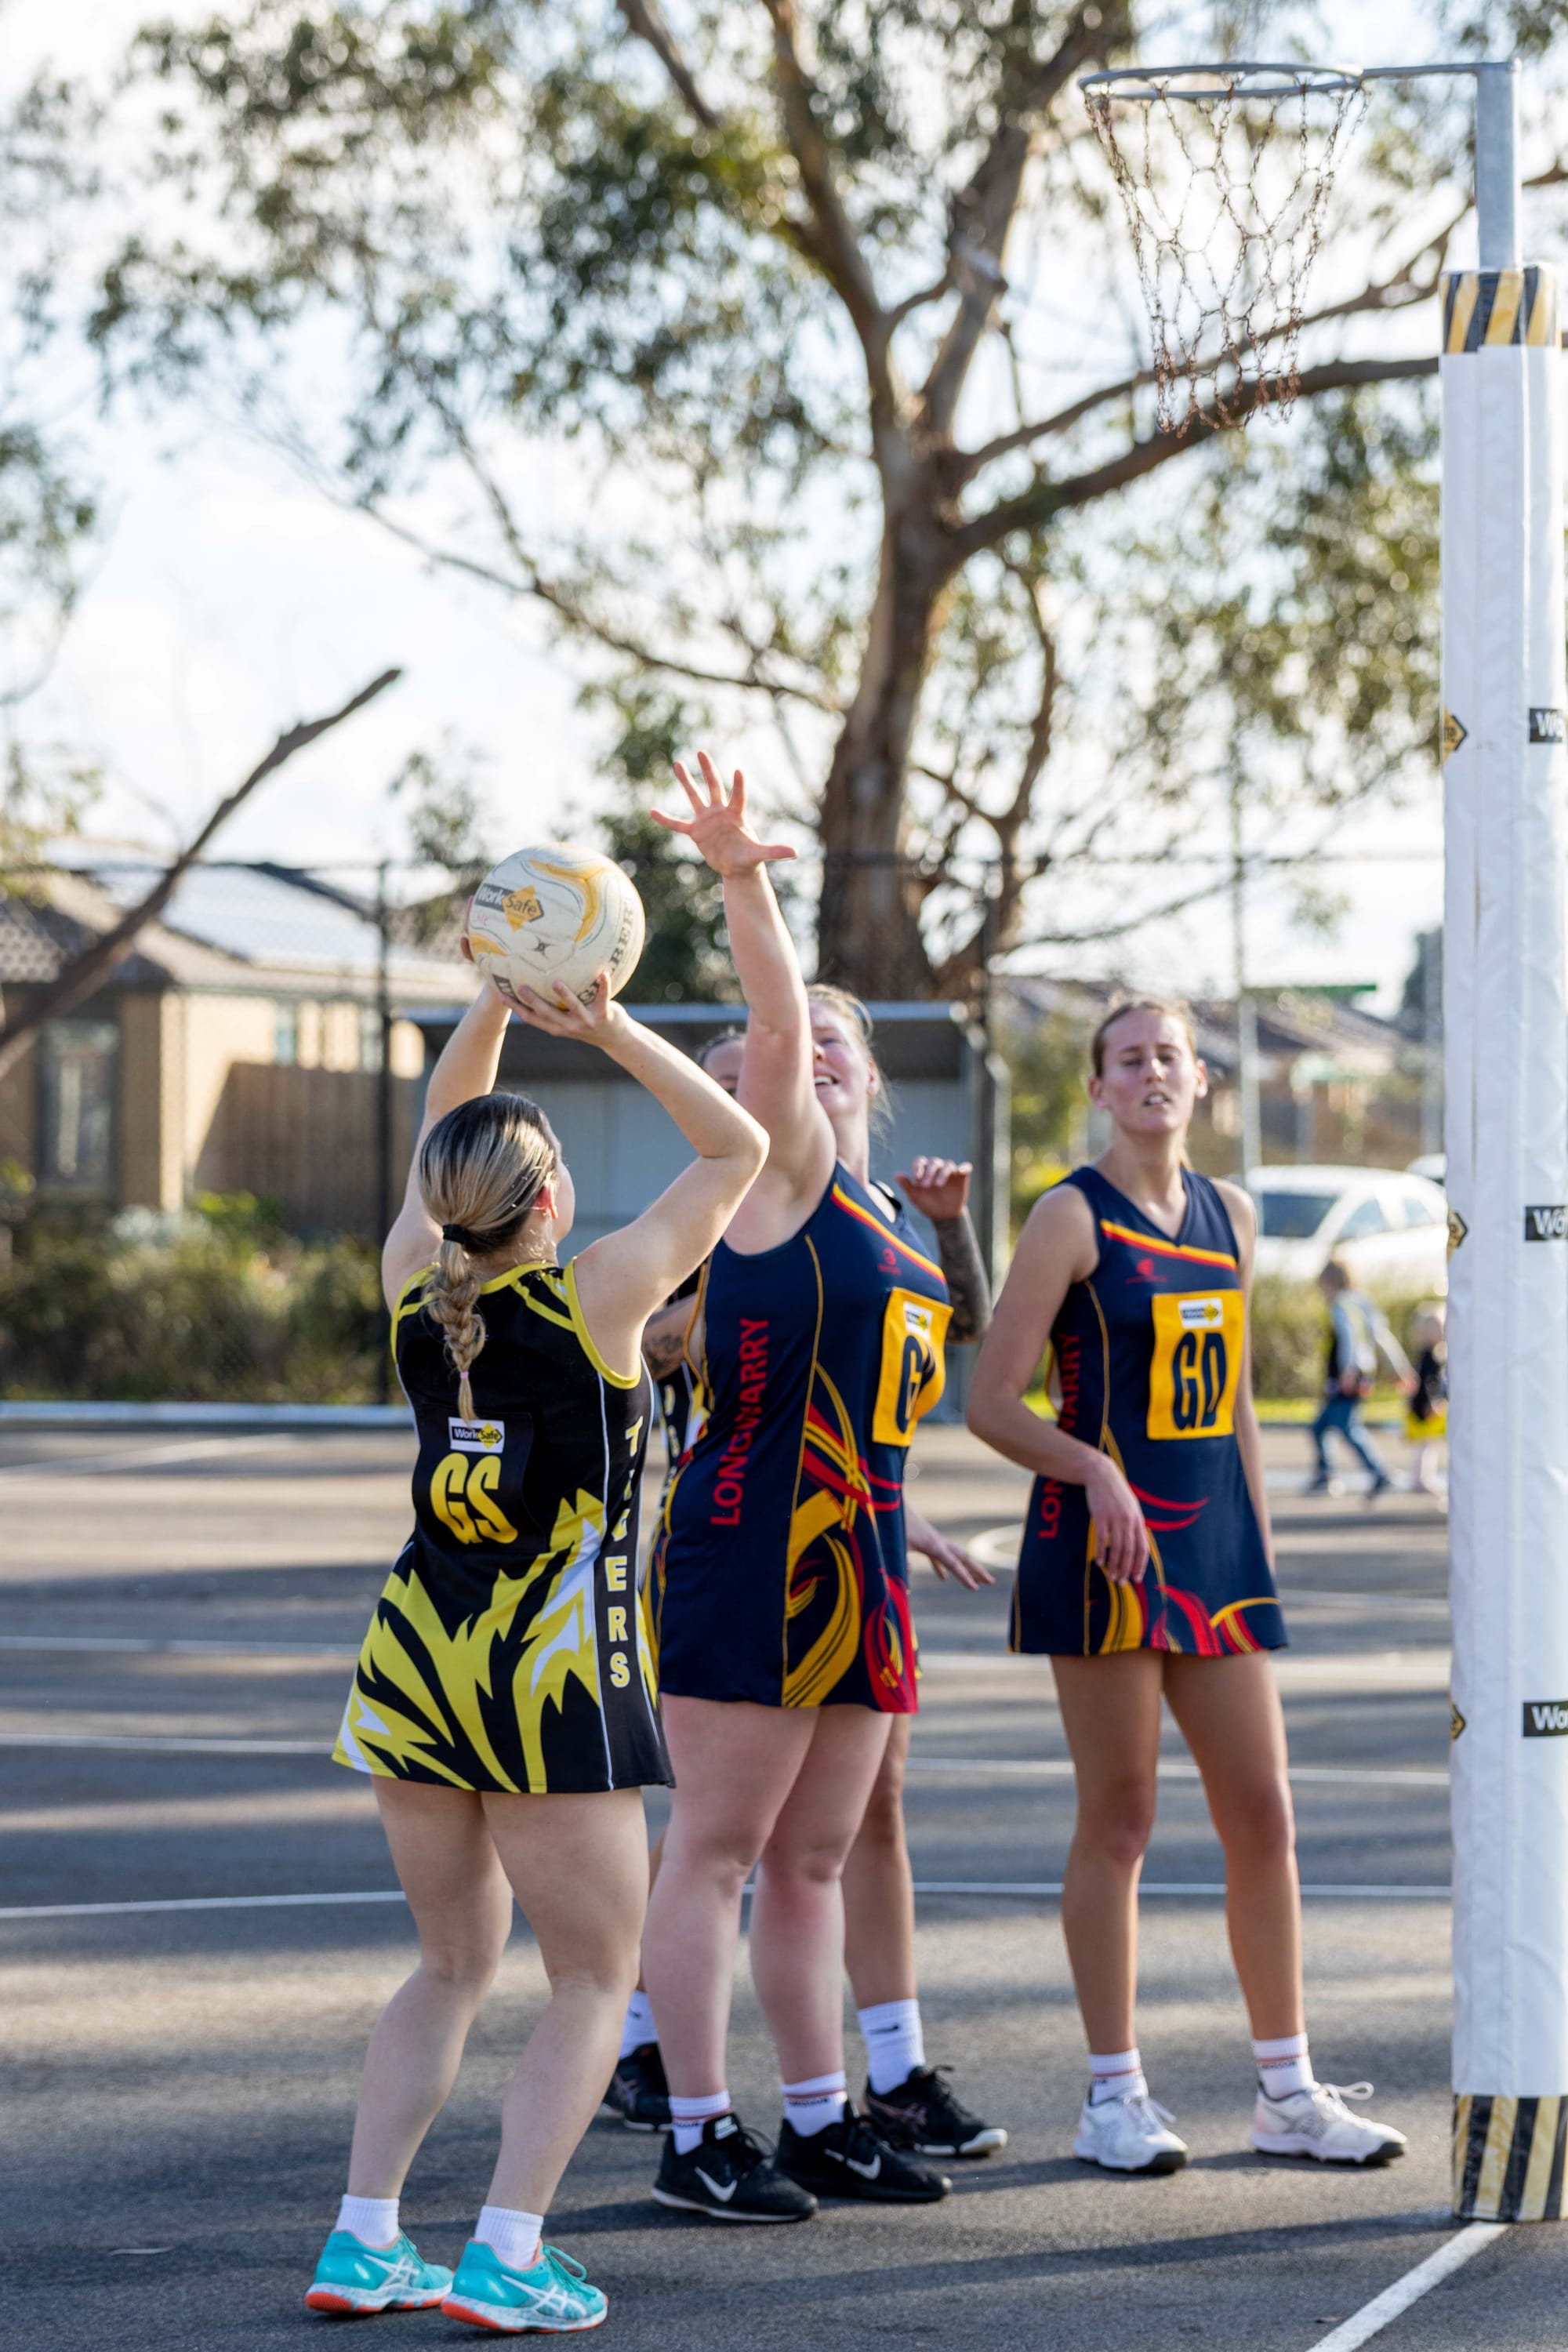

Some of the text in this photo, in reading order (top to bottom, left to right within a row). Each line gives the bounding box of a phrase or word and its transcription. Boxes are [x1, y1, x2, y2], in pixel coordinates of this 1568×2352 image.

[710, 1317, 769, 1526] LONGWARRY
[1172, 1330, 1227, 1430] GD
[430, 1452, 518, 1544] GS
[604, 1415, 644, 1688] TIGERS
